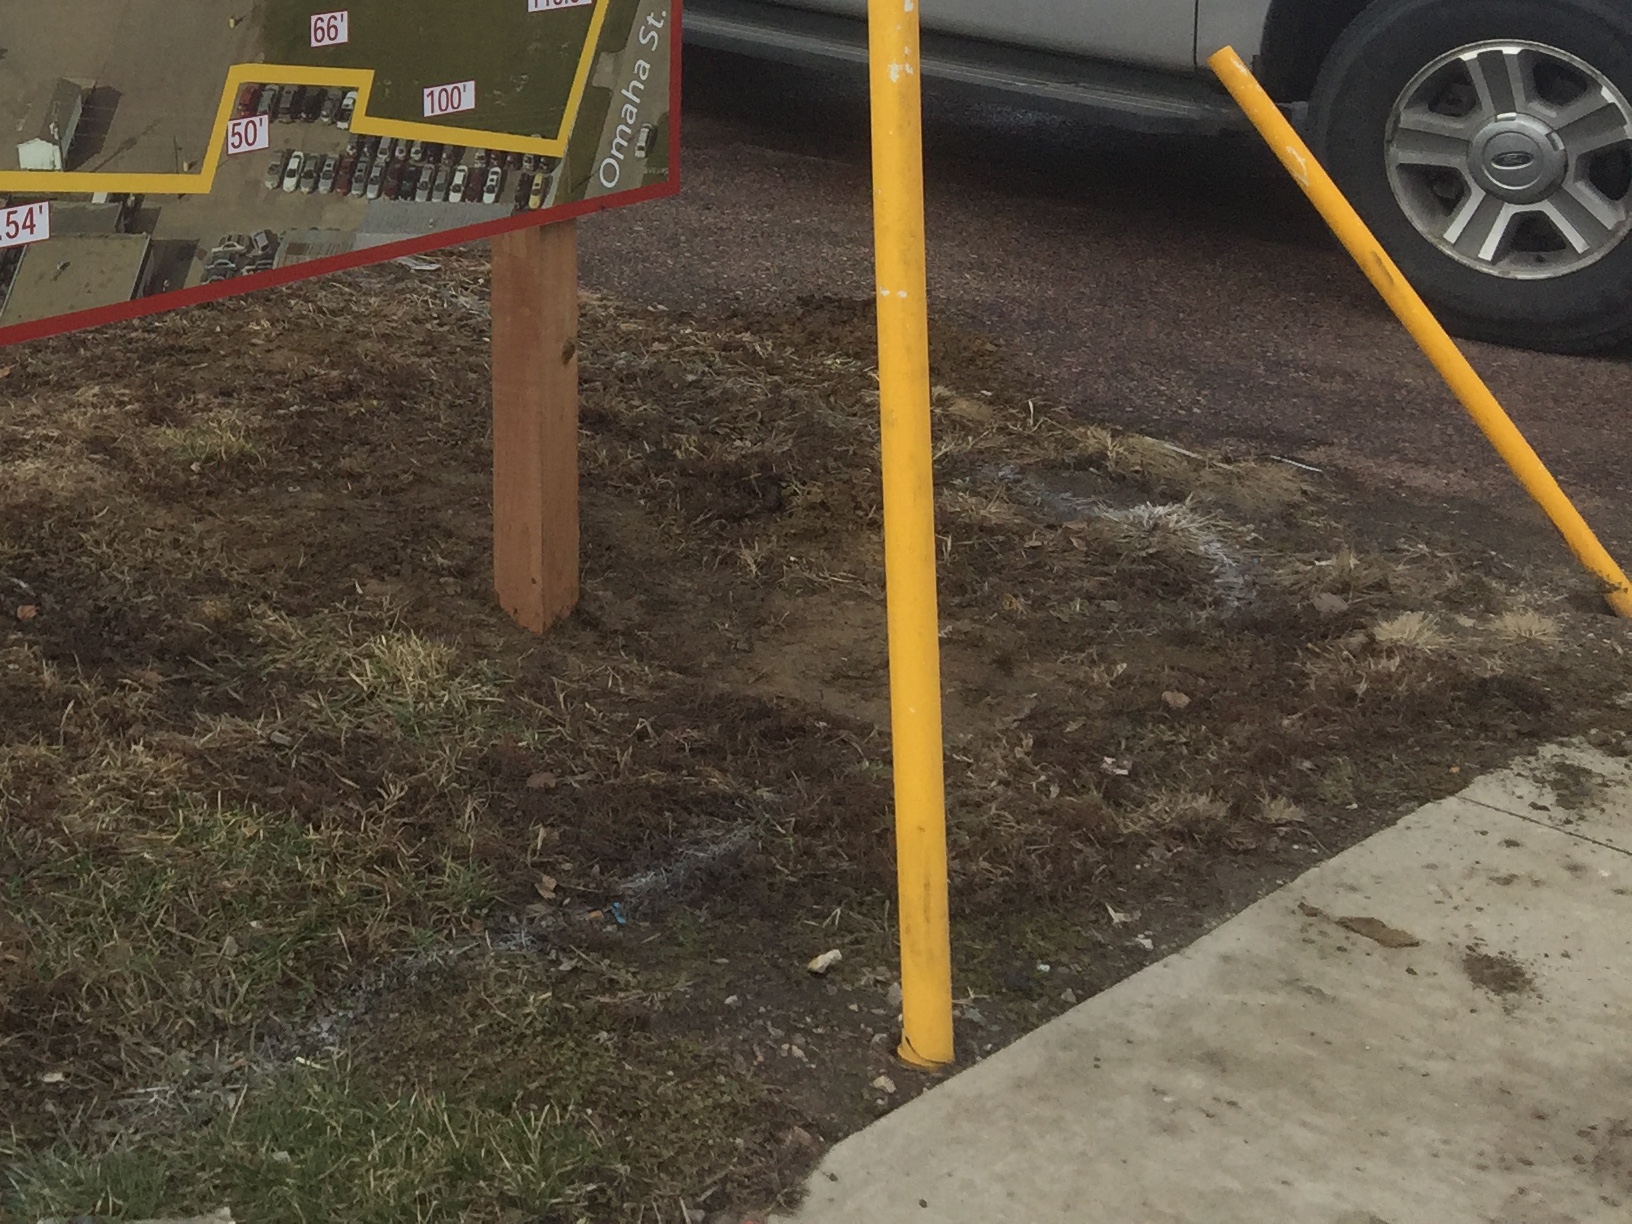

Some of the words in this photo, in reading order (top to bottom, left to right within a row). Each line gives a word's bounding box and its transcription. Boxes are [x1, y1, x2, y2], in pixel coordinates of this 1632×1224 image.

[312, 14, 345, 43] 66'
[426, 85, 468, 113] 100'
[599, 59, 651, 188] Omaha
[639, 9, 667, 51] St.
[230, 116, 263, 148] 50'
